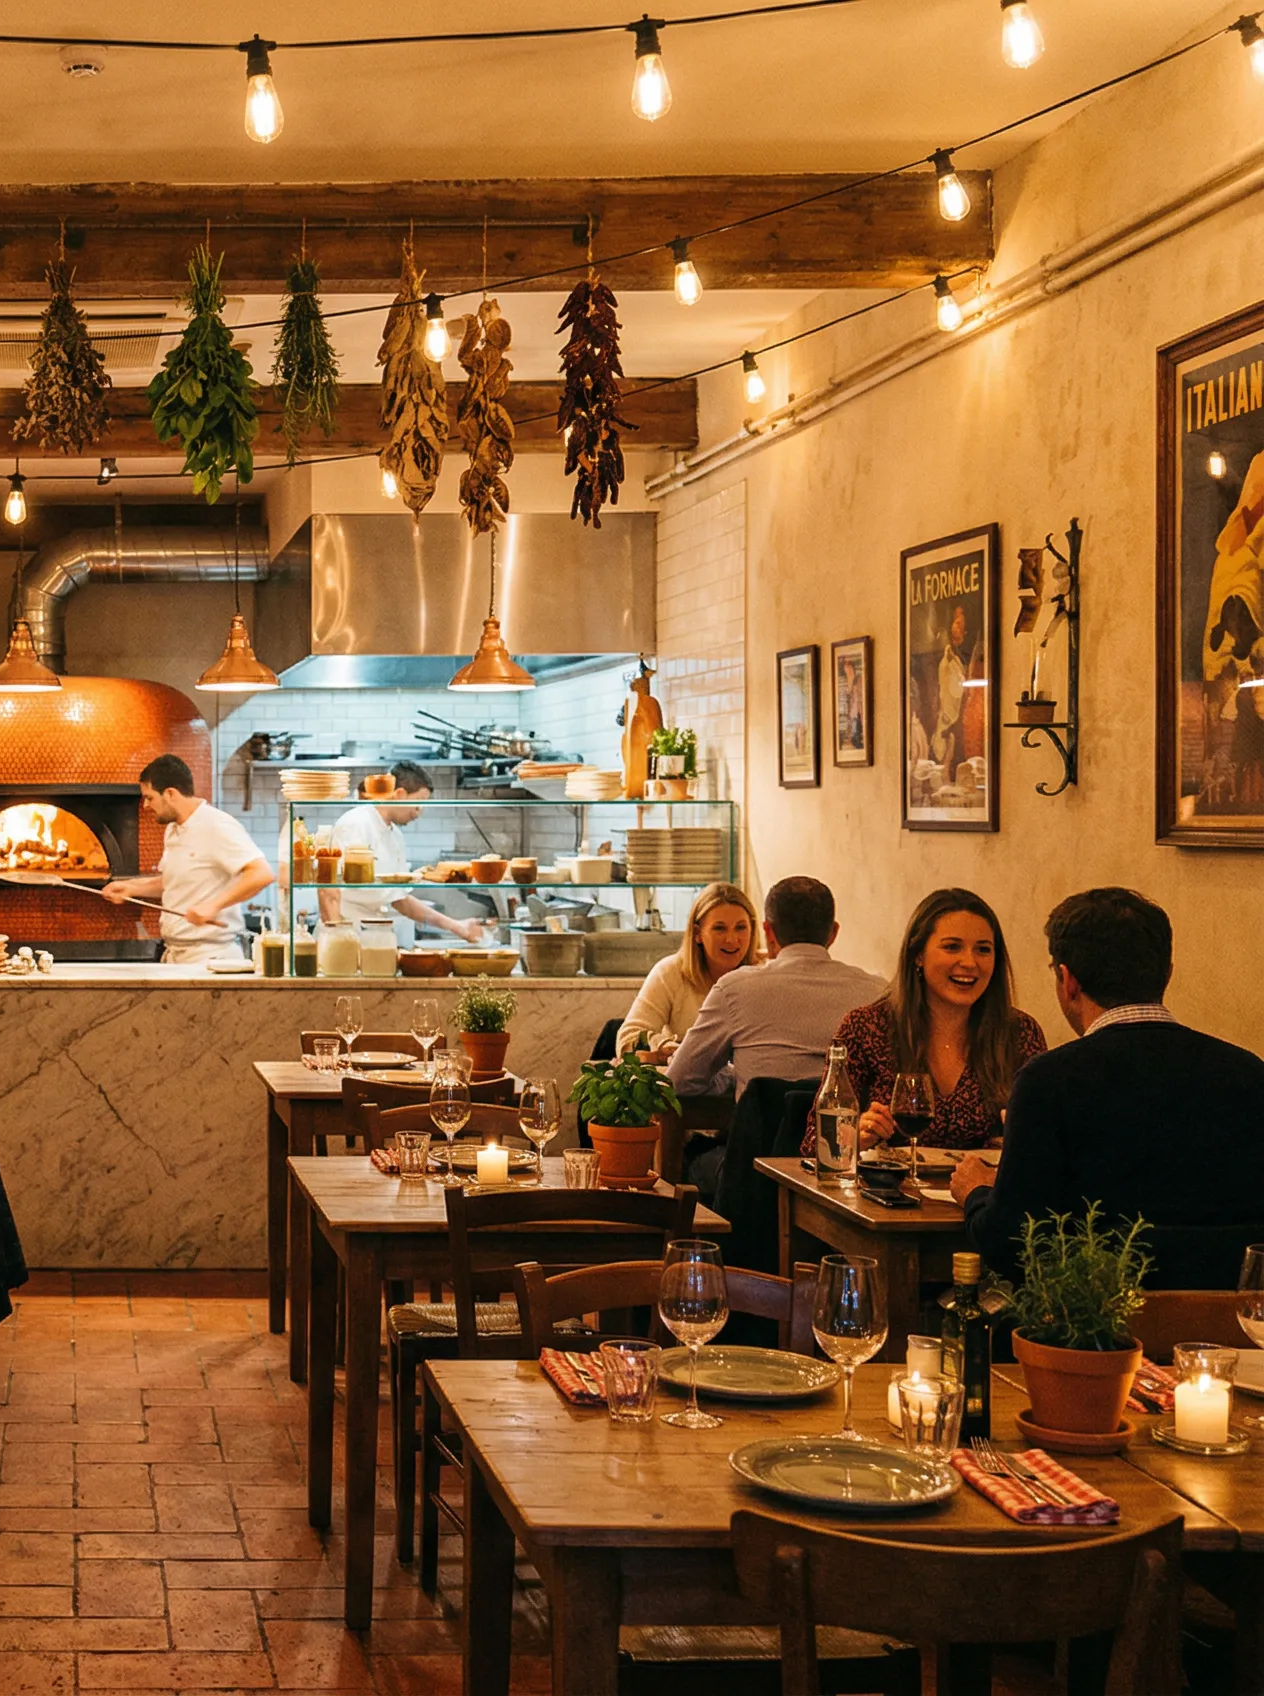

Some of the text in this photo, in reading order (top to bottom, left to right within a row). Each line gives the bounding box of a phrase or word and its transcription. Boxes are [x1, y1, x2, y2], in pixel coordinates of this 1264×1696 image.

[1187, 360, 1263, 433] ITALIAN
[911, 562, 980, 606] LA FORNACE
